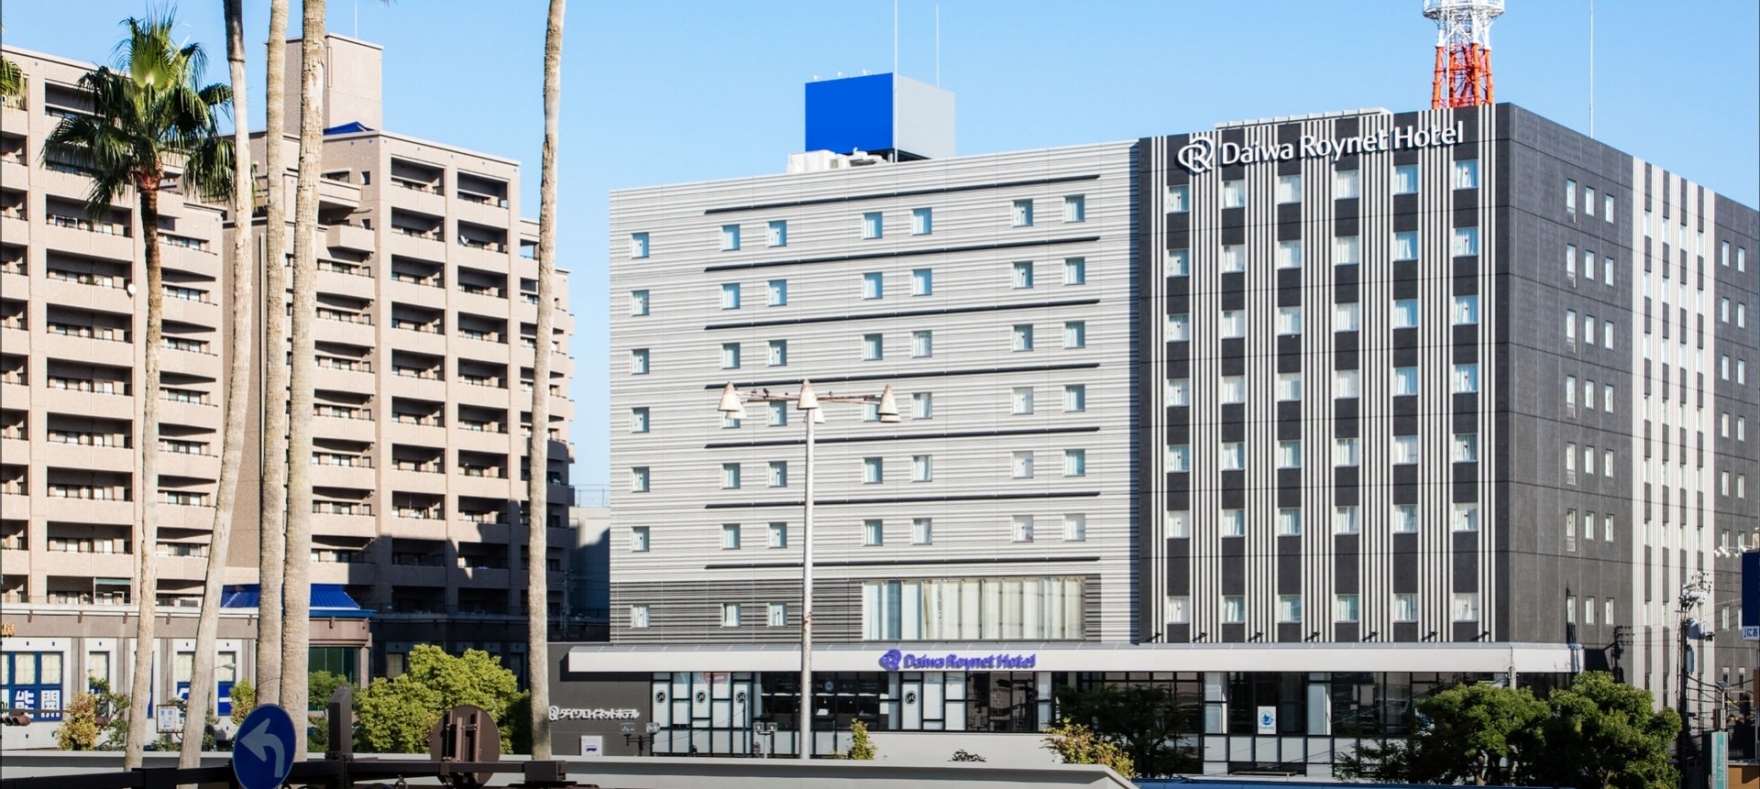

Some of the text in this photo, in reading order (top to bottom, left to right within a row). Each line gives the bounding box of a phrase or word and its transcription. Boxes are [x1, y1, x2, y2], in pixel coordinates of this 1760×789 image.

[1222, 141, 1294, 165] Daiwa
[1300, 129, 1389, 162] Roynet
[1394, 121, 1463, 149] Hotel
[903, 654, 945, 669] Daiwa
[946, 654, 996, 671] Roynet
[996, 654, 1036, 669] Hotel
[560, 708, 640, 719] ダイワロイネットホテル
